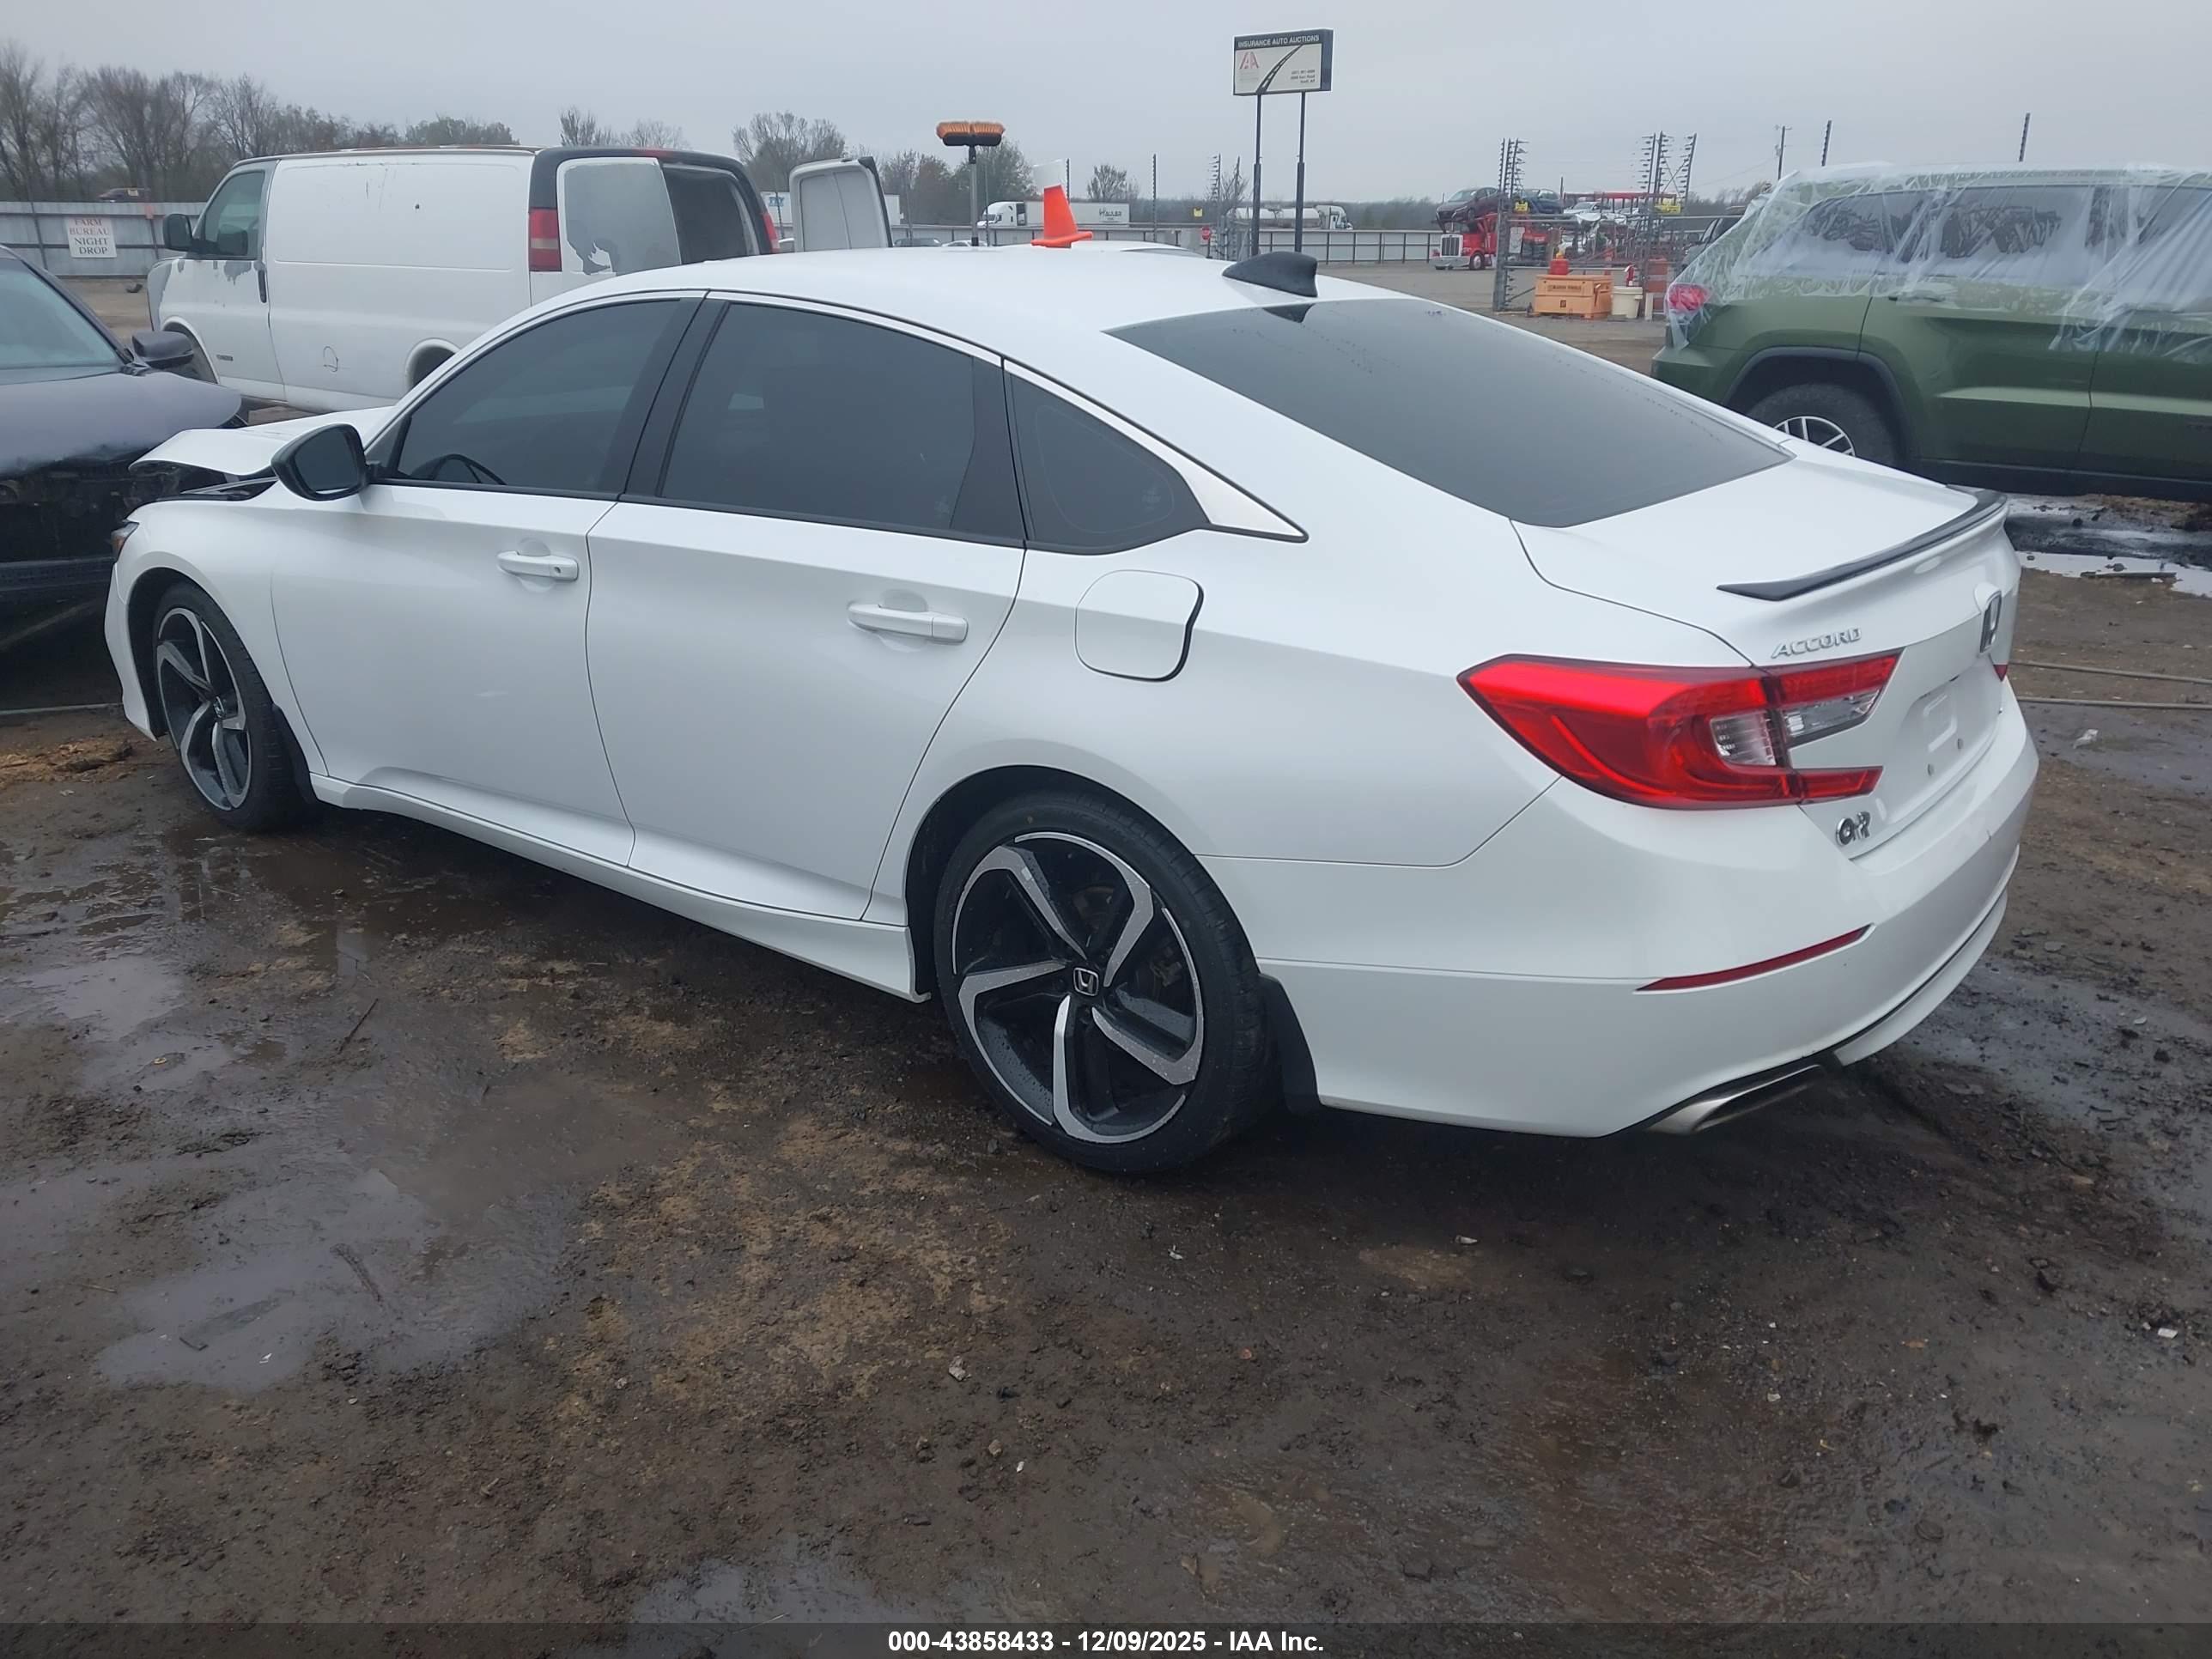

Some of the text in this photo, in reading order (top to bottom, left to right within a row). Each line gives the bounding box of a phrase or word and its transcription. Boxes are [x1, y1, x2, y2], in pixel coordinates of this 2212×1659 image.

[1238, 34, 1320, 49] INSURANCE AUTO AUCTIONS
[75, 218, 102, 227] FARM
[70, 227, 110, 235] BUREAU
[74, 237, 108, 246] NIGHT
[79, 246, 107, 255] DROP
[1771, 627, 1862, 659] ACCORD
